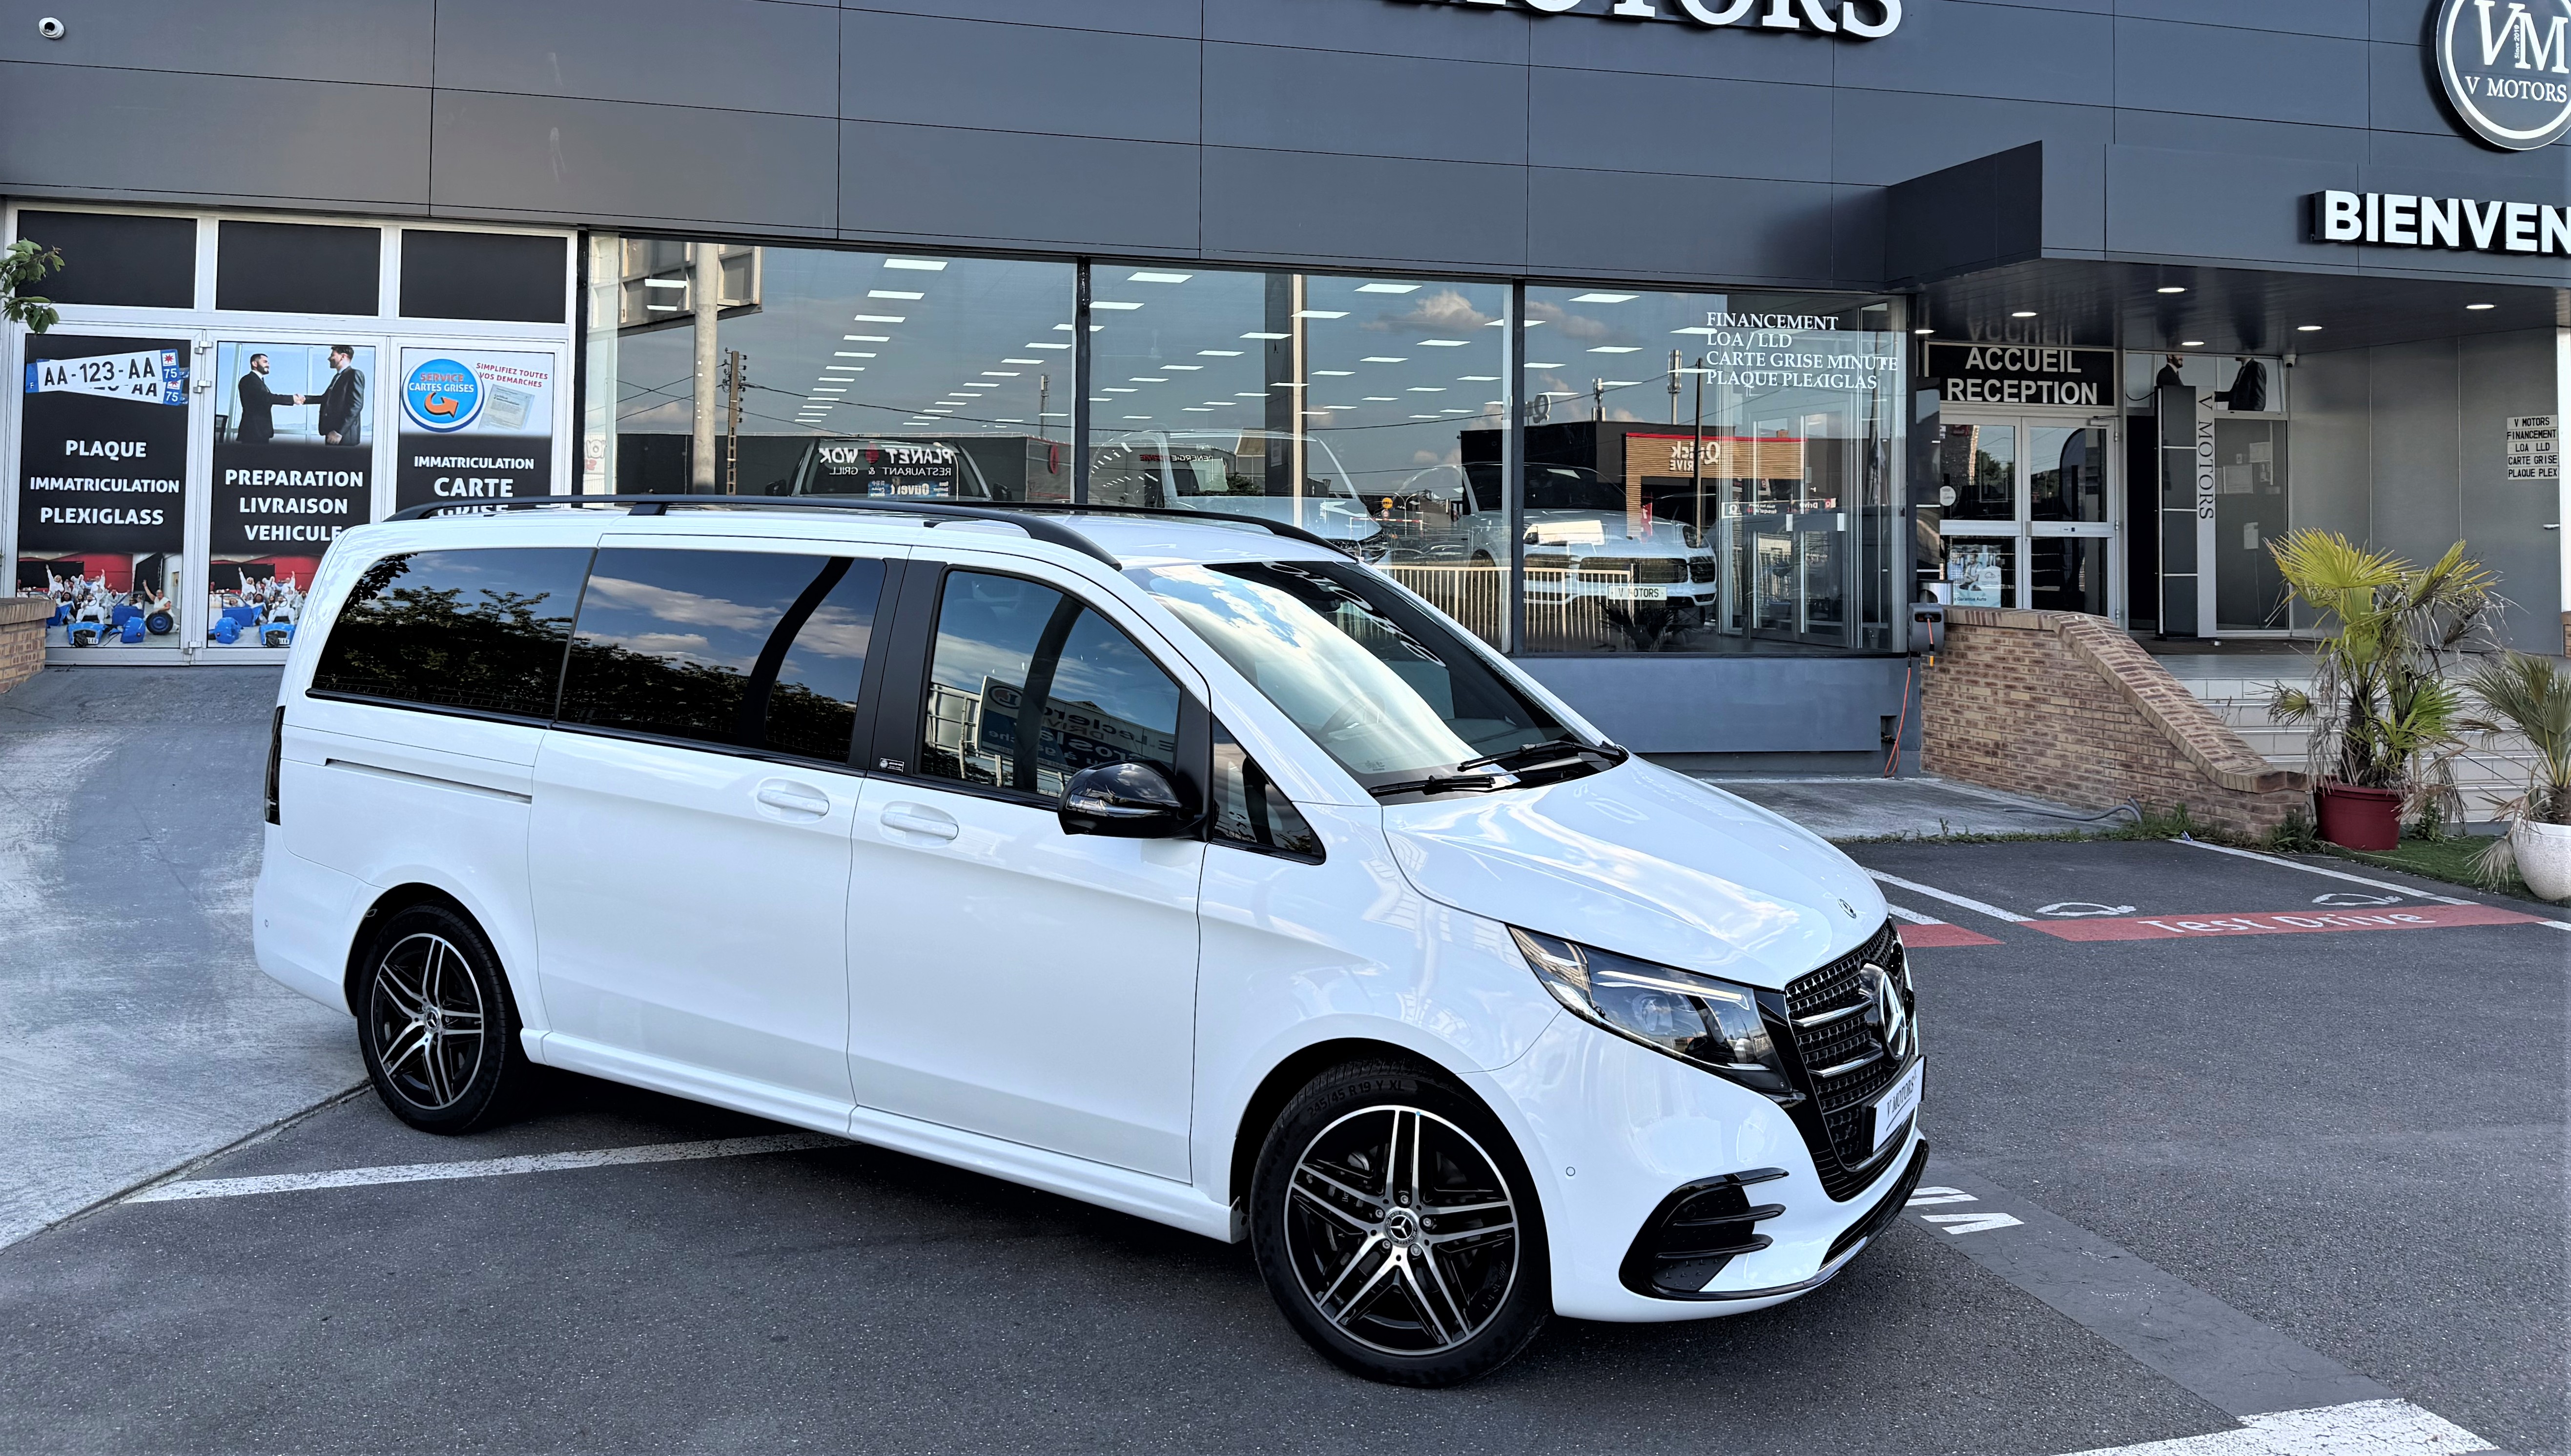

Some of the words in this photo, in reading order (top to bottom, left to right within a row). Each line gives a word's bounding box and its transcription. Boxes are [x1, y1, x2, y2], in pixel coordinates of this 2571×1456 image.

[2465, 76, 2480, 94] V
[2487, 78, 2568, 103] MOTORS
[2325, 189, 2571, 253] BIENVEN
[1707, 311, 1839, 330] FINANCEMENT
[1707, 351, 1765, 367] CARTE
[1770, 352, 1823, 369] GRISE
[1827, 355, 1898, 371] MINUTE
[1965, 348, 2082, 373] ACCUEIL
[164, 368, 178, 379] 75
[420, 372, 464, 383] SERVICE
[476, 363, 517, 375] SIMPLIFIEZ
[519, 369, 549, 380] TOUTES
[1707, 370, 1779, 389] PLAQUE
[1783, 371, 1877, 390] PLEXIGLAS
[409, 382, 442, 392] CARTES
[444, 383, 474, 393] GRISES
[496, 375, 542, 388] DEMARCHES
[165, 391, 179, 402] 75
[1947, 378, 2098, 405] RECEPTION
[2198, 393, 2213, 411] V
[2514, 418, 2519, 427] V
[2522, 417, 2550, 427] MOTORS
[2507, 429, 2557, 440] FINANCEMENT
[65, 440, 147, 461] PLAQUE
[2515, 443, 2529, 452] LOA
[2536, 442, 2550, 451] LLD
[414, 456, 534, 470] IMMATRICULATION
[2508, 456, 2530, 465] CARTE
[2534, 455, 2558, 464] GRISE
[2198, 420, 2214, 520] MOTORS
[2508, 469, 2535, 478] PLAQUE
[2539, 468, 2557, 477] PLEX
[30, 477, 180, 493] IMMATRICULATION
[225, 470, 364, 488] PREPARATION
[434, 477, 514, 498] CARTE
[240, 497, 348, 514] LIVRAISON
[41, 508, 164, 525] PLEXIGLASS
[245, 525, 343, 542] VEHICULE
[1618, 588, 1624, 597] V
[2139, 918, 2277, 933] Test
[2272, 912, 2437, 929] Drive
[1887, 1099, 1892, 1117] V
[1892, 1077, 1914, 1112] MOTORS
